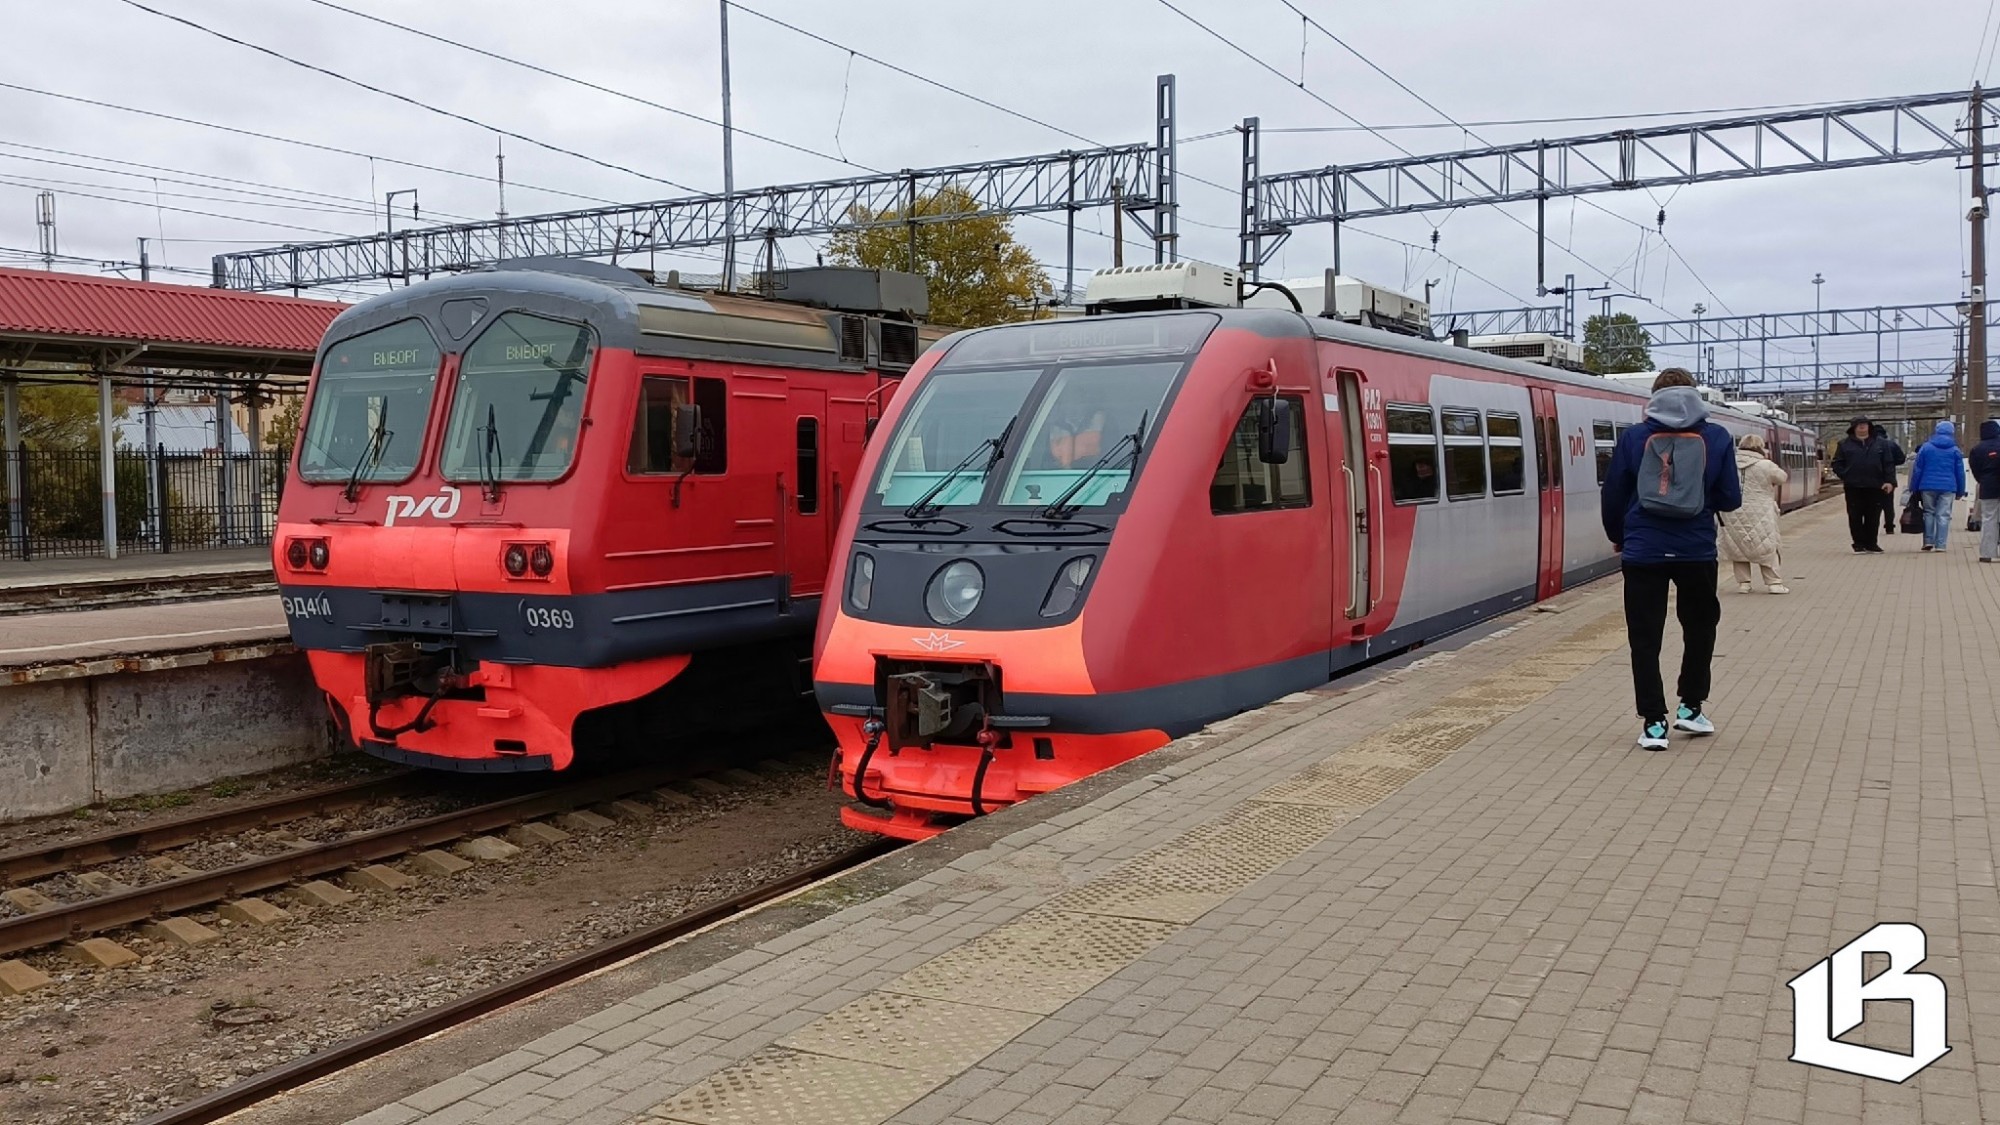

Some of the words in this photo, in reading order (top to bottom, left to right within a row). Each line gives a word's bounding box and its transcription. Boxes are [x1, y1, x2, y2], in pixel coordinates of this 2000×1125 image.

[373, 349, 419, 366] ВЫБОРГ
[506, 344, 556, 360] ВЫБОРГ
[282, 596, 331, 618] ЭД4М
[526, 607, 574, 629] 0369
